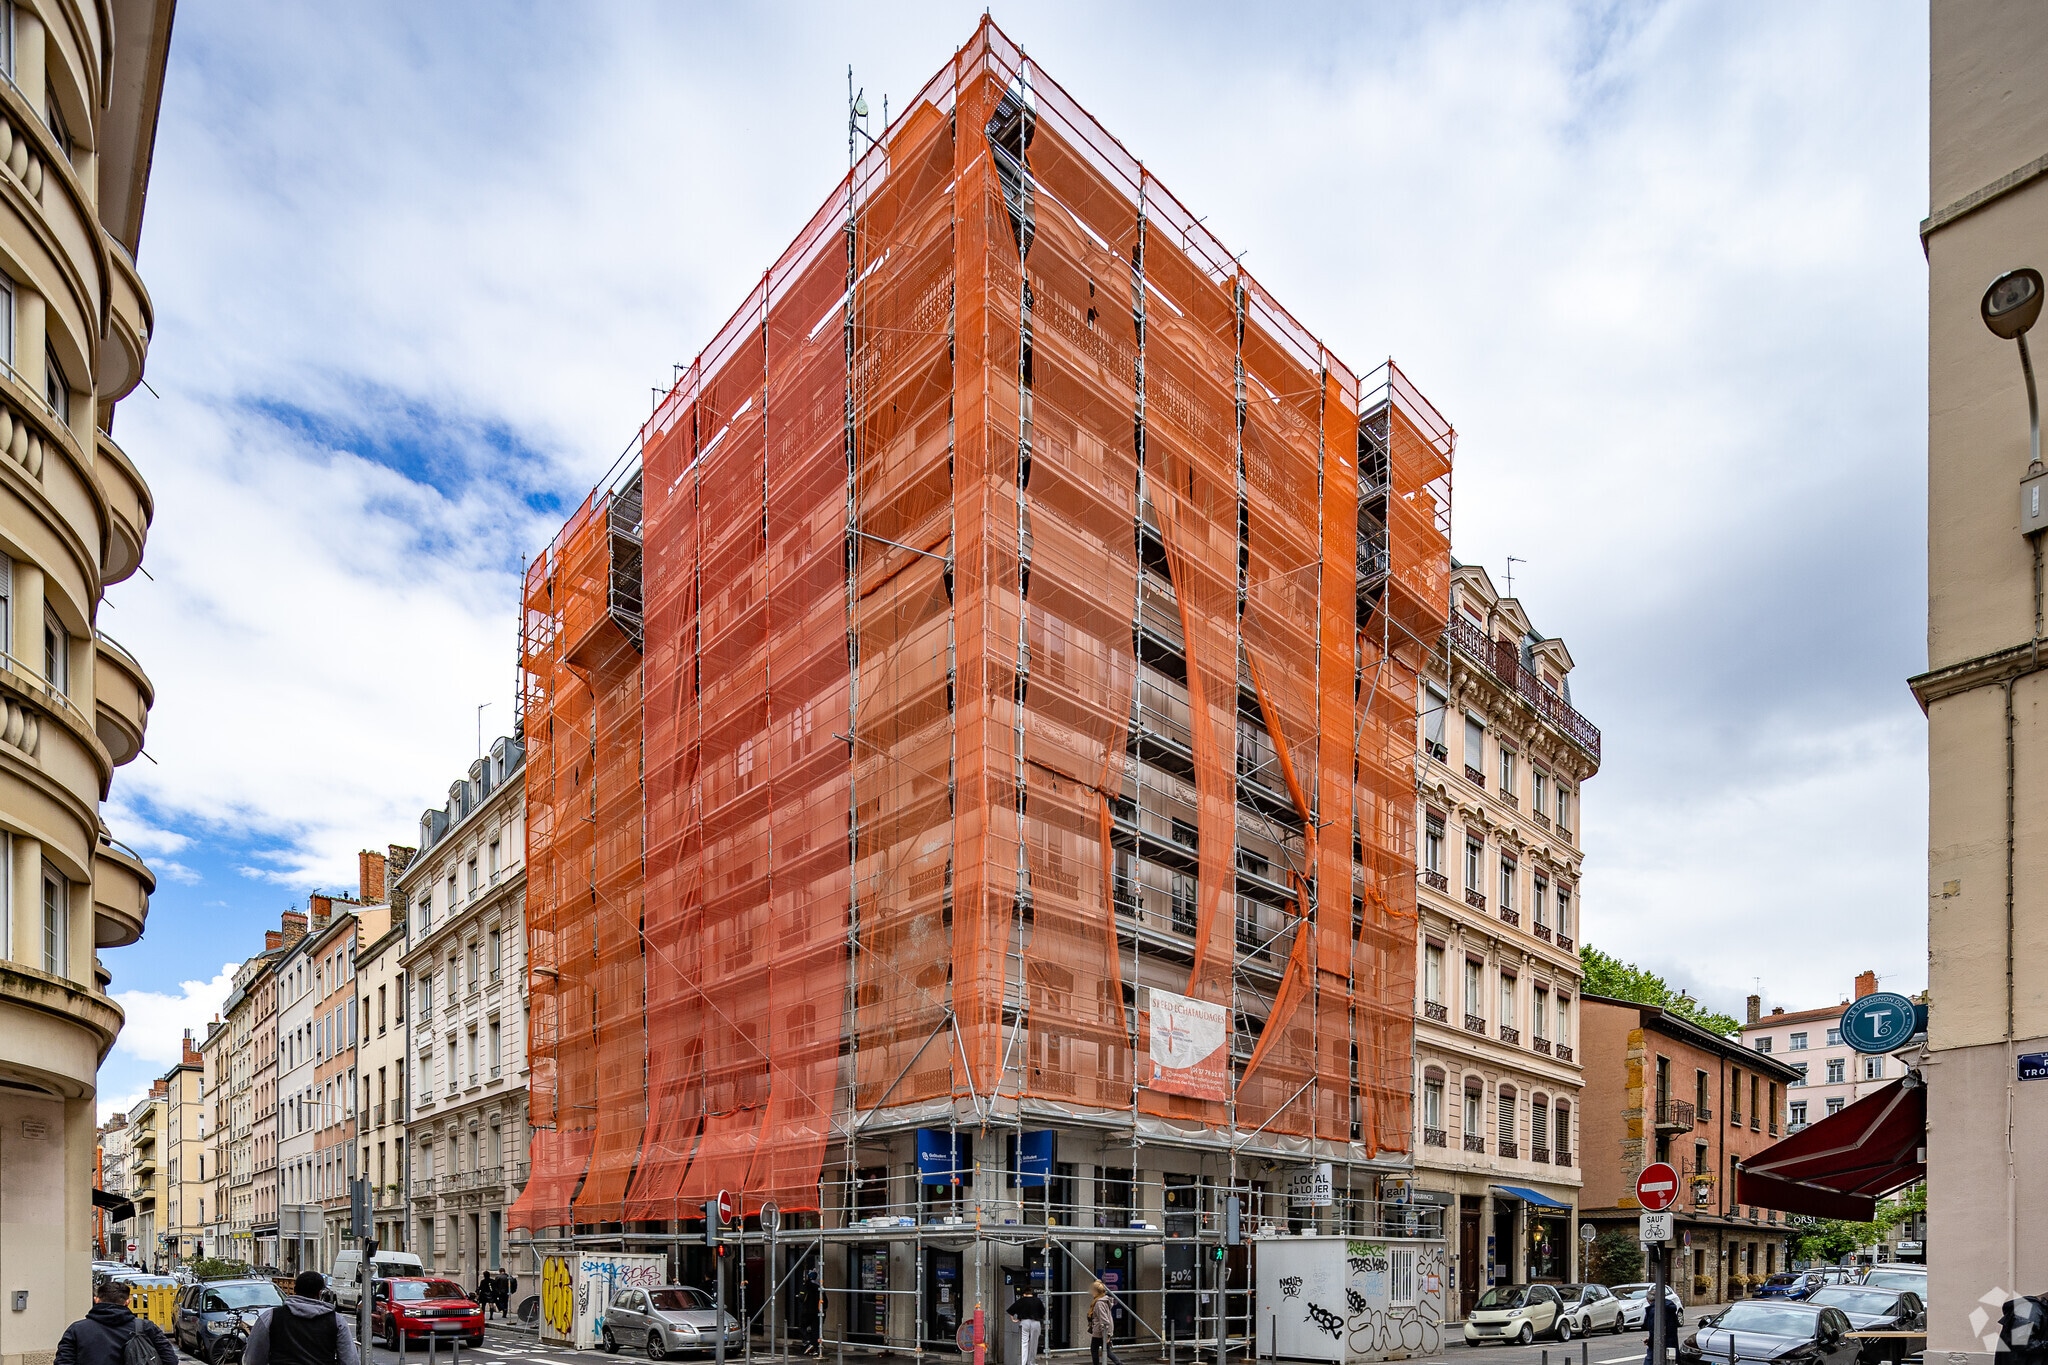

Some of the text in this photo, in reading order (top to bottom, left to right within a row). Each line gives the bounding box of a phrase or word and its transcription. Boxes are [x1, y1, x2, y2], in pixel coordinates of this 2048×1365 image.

[1849, 1010, 1857, 1018] LE
[1856, 996, 1894, 1010] TABAGNON
[2025, 1068, 2048, 1077] TRO
[1386, 1187, 1406, 1198] gan
[1646, 1215, 1664, 1224] SAUF
[1793, 1216, 1816, 1224] ORSI
[1006, 1274, 1012, 1284] P
[1170, 1269, 1192, 1283] 50%
